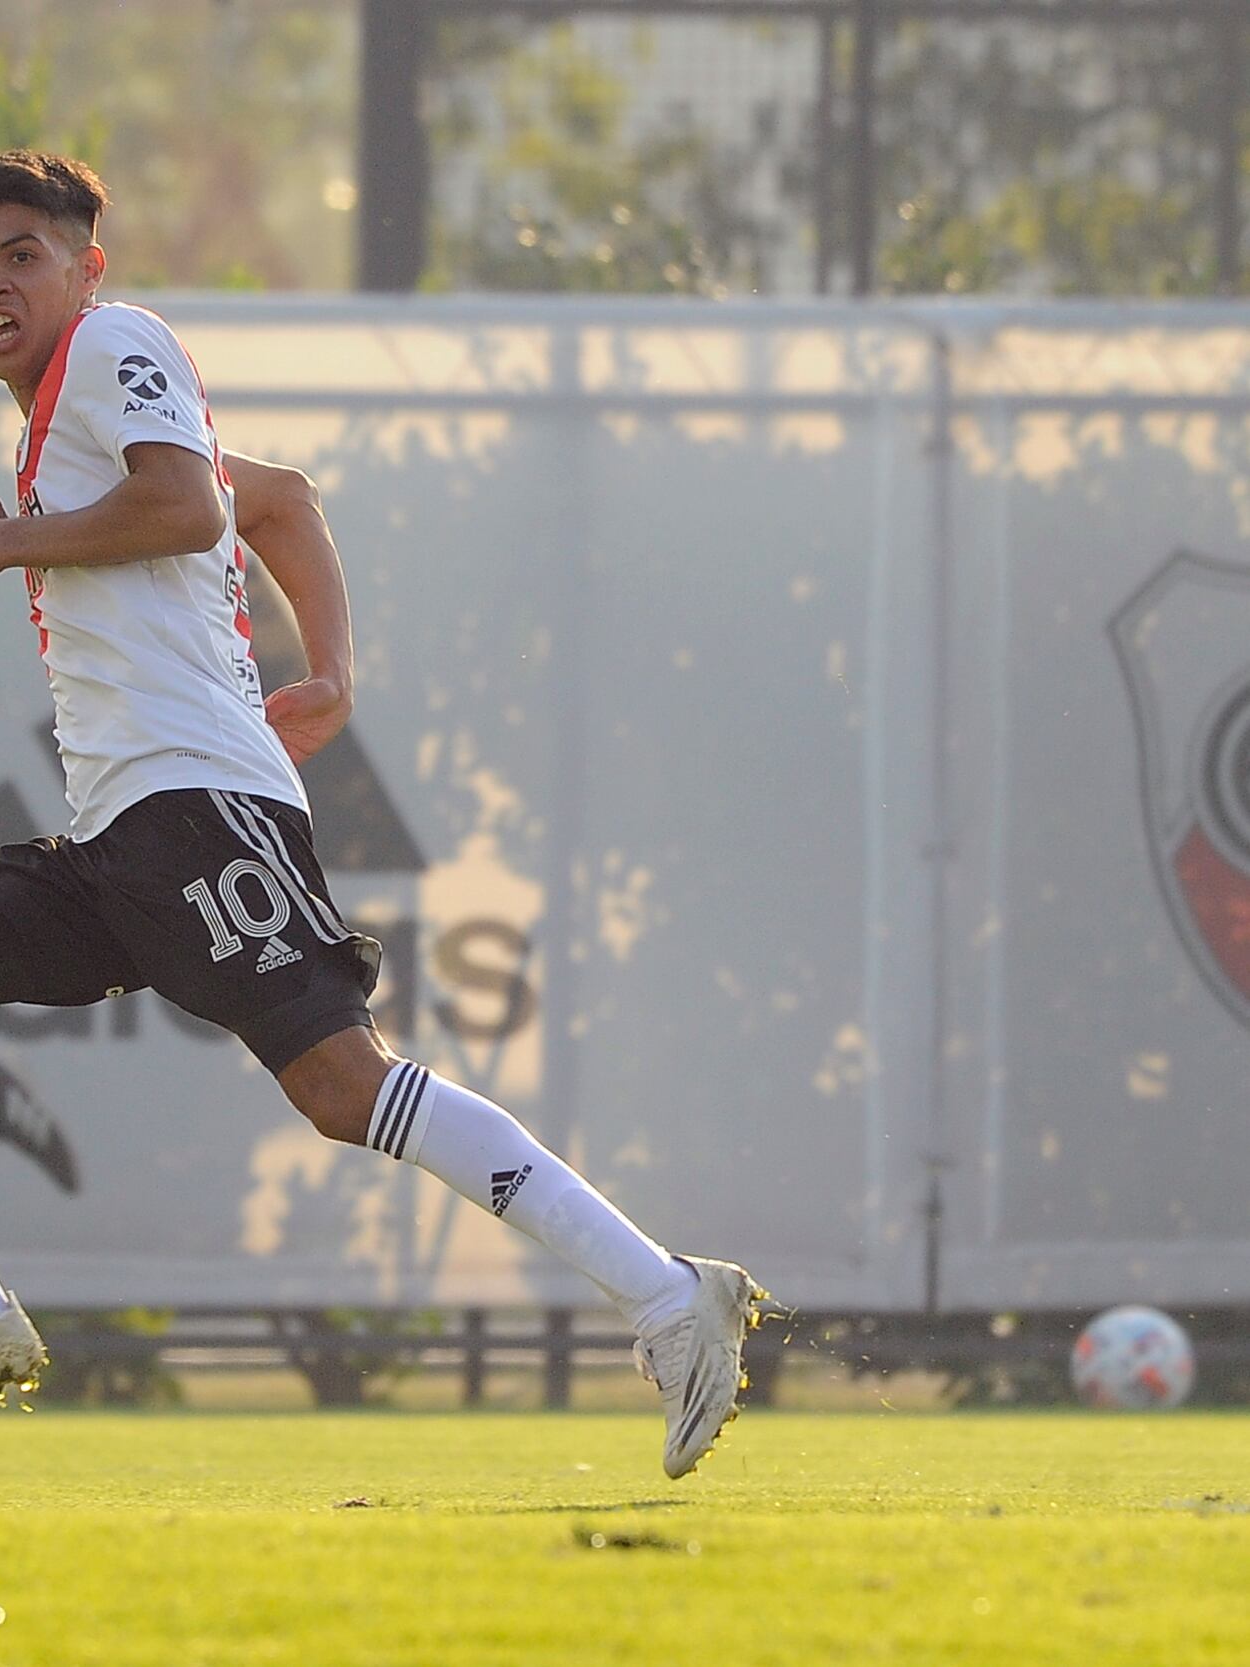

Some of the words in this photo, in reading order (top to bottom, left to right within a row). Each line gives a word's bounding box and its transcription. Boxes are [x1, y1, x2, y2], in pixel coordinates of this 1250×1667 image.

[182, 858, 291, 963] 10
[256, 949, 304, 974] adidas
[494, 1163, 533, 1217] adidas
